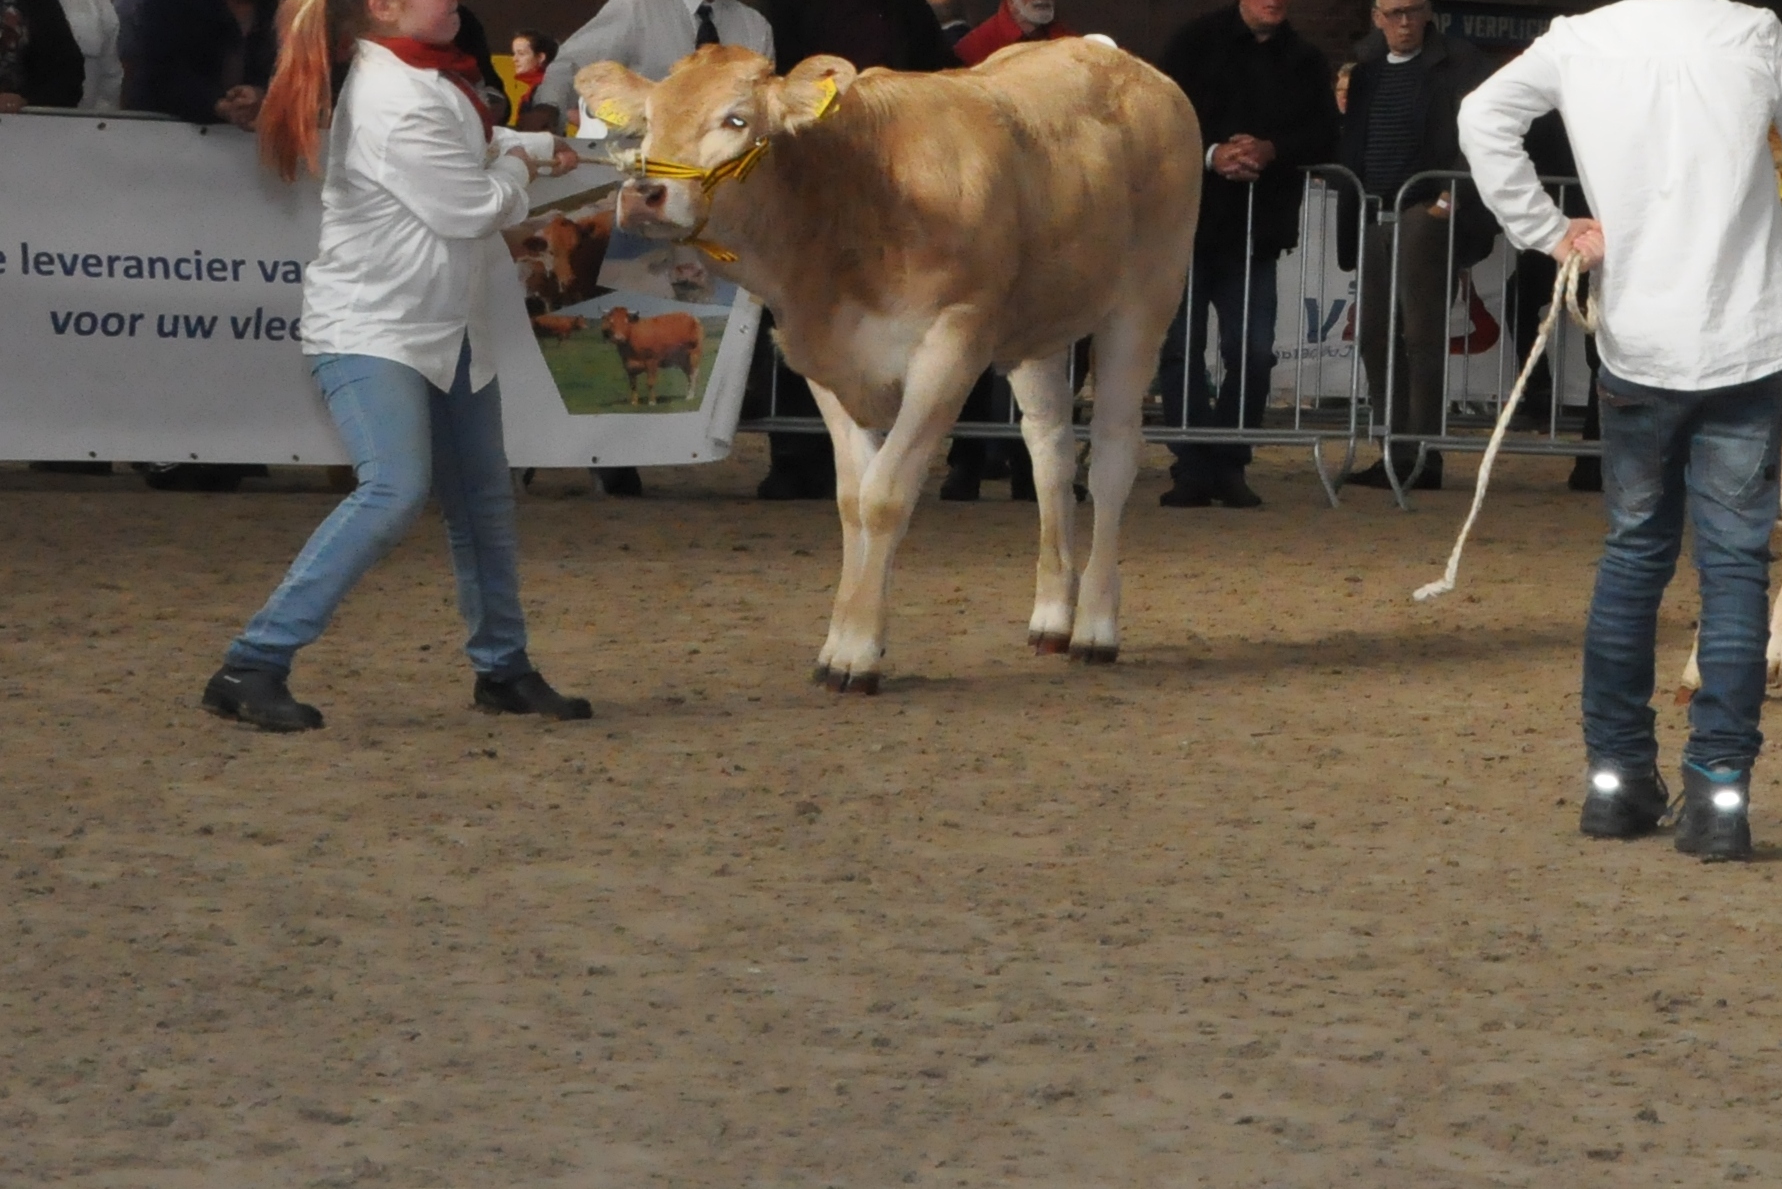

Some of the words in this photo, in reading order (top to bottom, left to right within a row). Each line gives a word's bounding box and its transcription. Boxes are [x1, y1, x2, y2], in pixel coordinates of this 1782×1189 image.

[20, 242, 246, 282] leverancier
[257, 259, 307, 284] va
[50, 310, 144, 337] voor
[156, 313, 218, 339] uw
